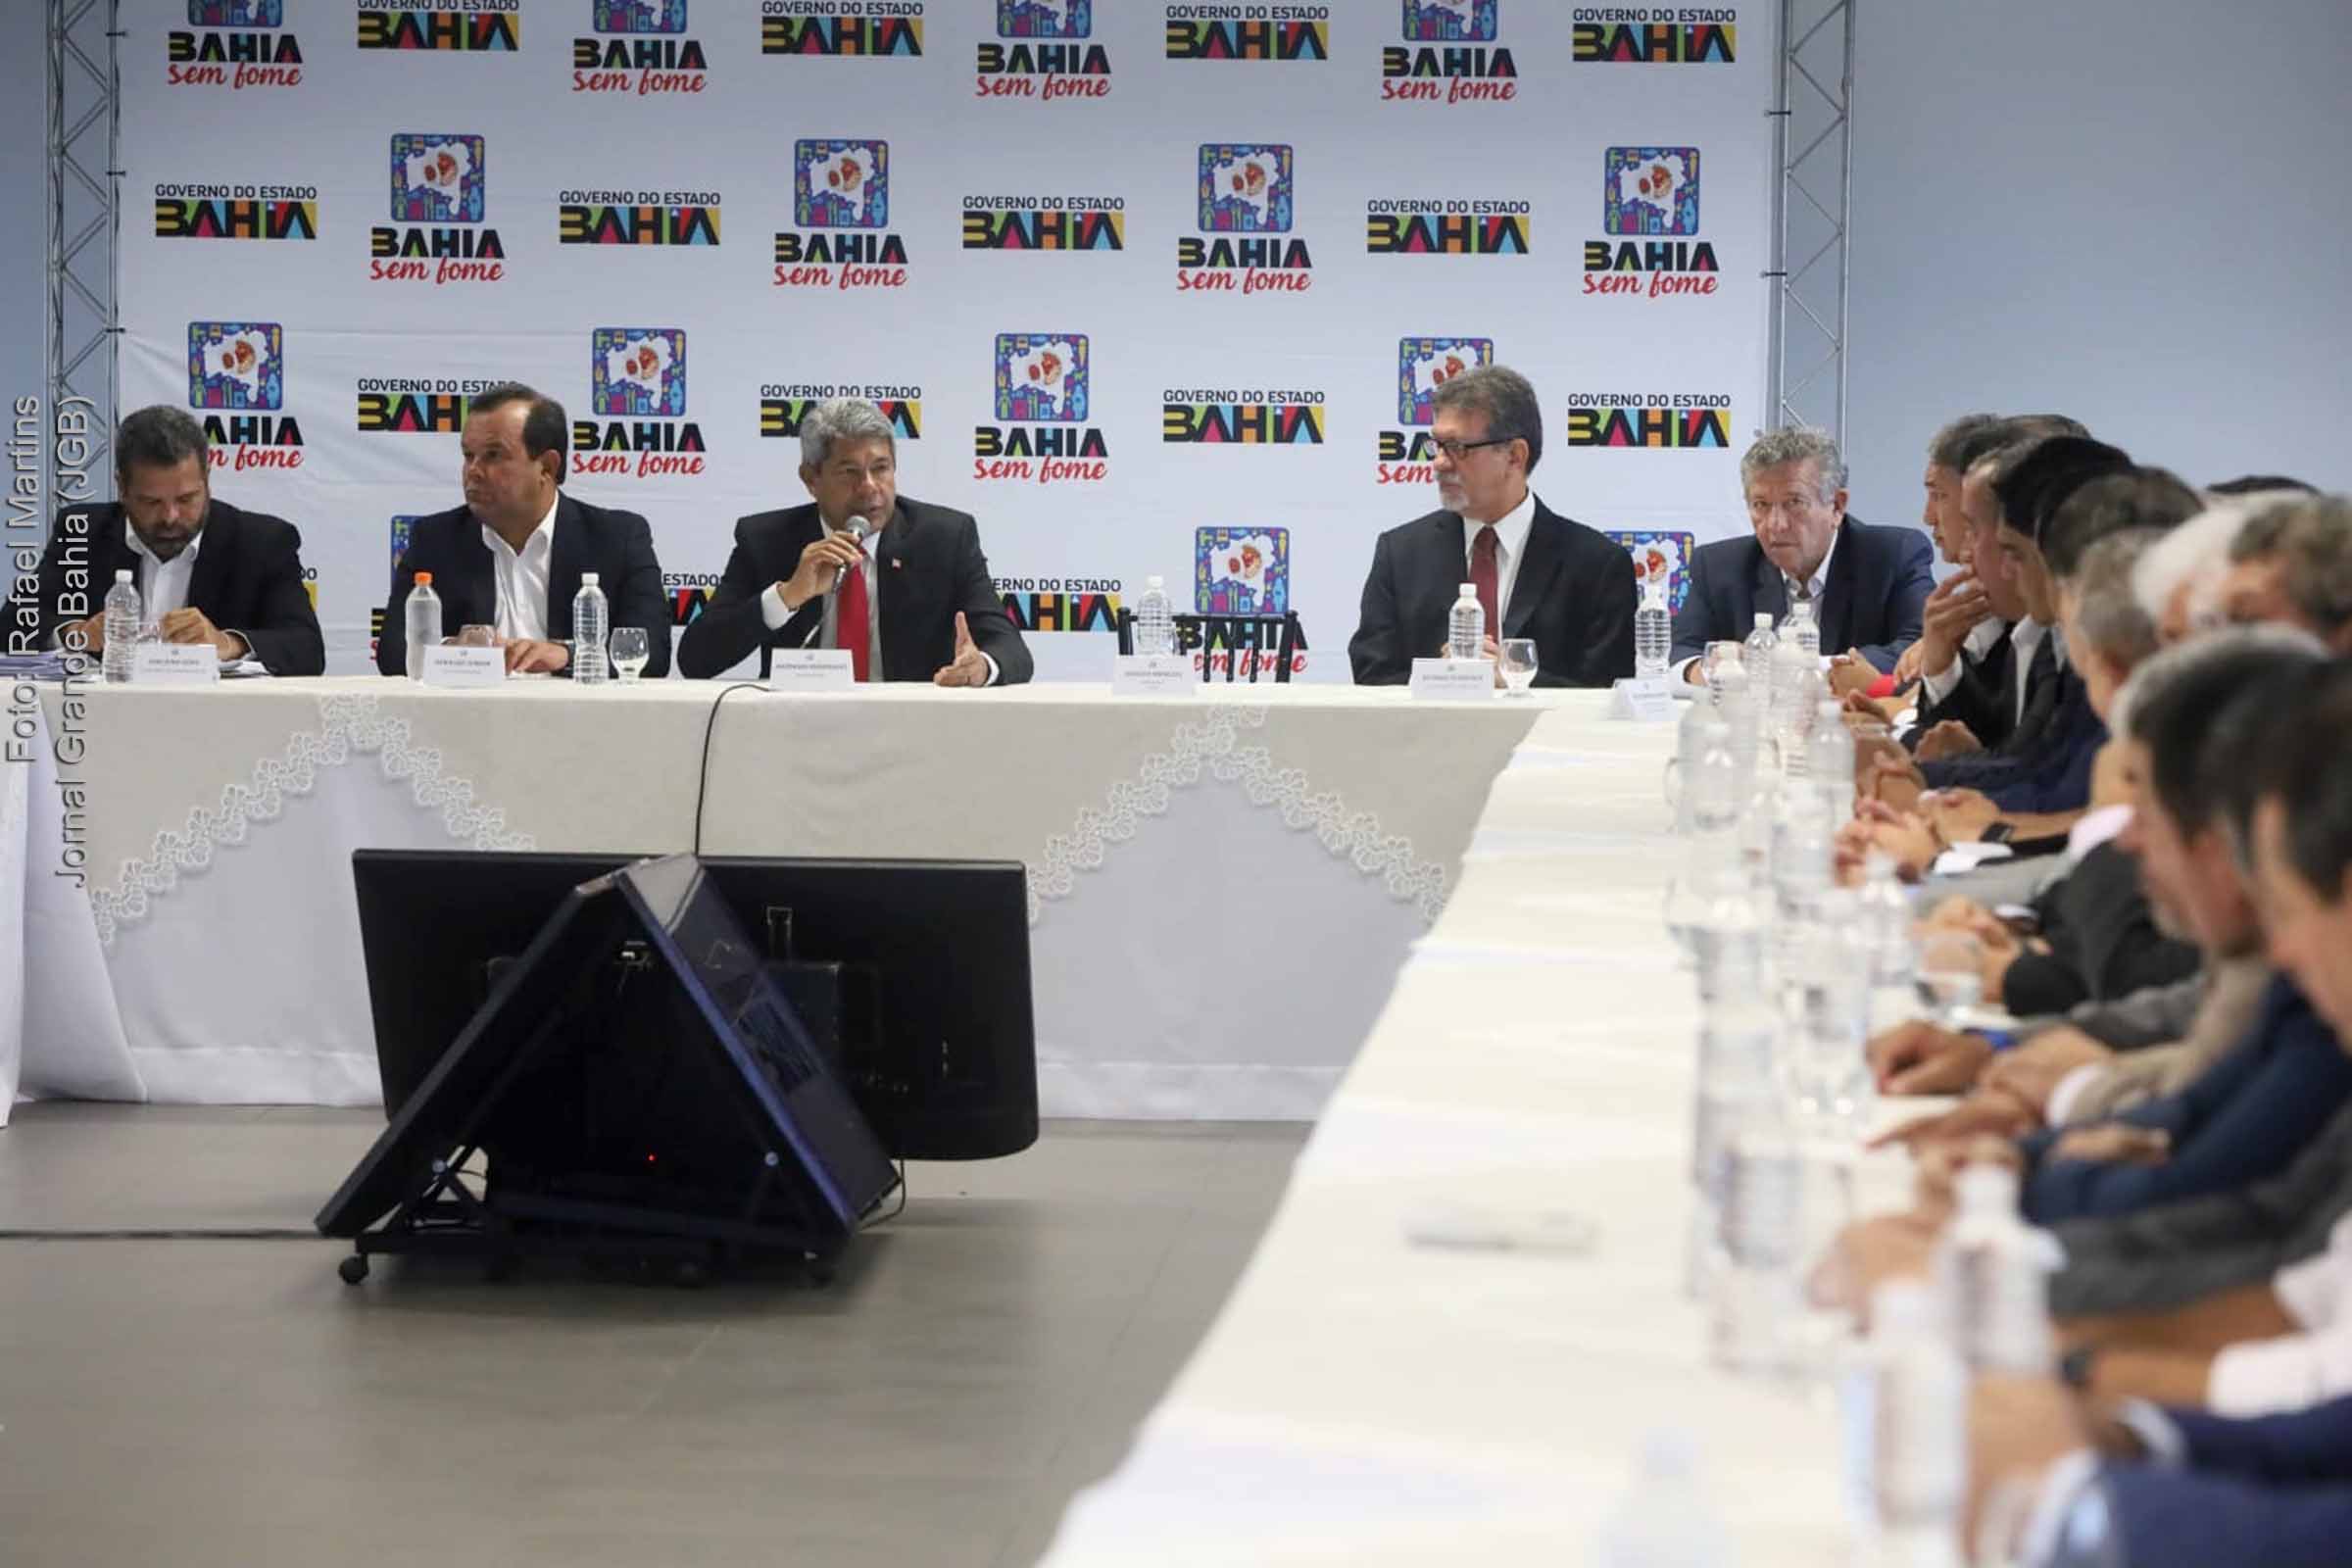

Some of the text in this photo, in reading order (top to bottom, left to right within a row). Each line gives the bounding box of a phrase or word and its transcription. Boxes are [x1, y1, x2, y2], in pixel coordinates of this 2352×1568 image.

[358, 0, 519, 11] GOVERNO DO ESTADO
[761, 2, 923, 17] GOVERNO DO ESTADO
[1166, 6, 1328, 21] GOVERNO DO ESTADO
[1573, 9, 1735, 24] GOVERNO DO ESTADO
[358, 11, 519, 49] BAHIA
[761, 17, 923, 55] BAHIA
[1166, 21, 1328, 59] BAHIA
[1573, 24, 1735, 62] BAHIA
[170, 32, 303, 63] BAHIA
[574, 39, 708, 70] BAHIA
[978, 44, 1111, 74] BAHIA
[1384, 47, 1517, 77] BAHIA
[168, 60, 302, 89] sem fome
[572, 67, 707, 96] sem fome
[976, 72, 1110, 101] sem fome
[1382, 74, 1516, 104] sem fome
[155, 184, 317, 199] GOVERNO DO ESTADO
[559, 191, 720, 206] GOVERNO DO ESTADO
[962, 196, 1124, 211] GOVERNO DO ESTADO
[155, 199, 317, 237] BAHIA
[1367, 200, 1529, 215] GOVERNO DO ESTADO
[559, 206, 720, 244] BAHIA
[962, 211, 1124, 249] BAHIA
[1367, 215, 1529, 253] BAHIA
[372, 227, 506, 258] BAHIA
[775, 233, 908, 264] BAHIA
[1179, 238, 1312, 269] BAHIA
[1586, 241, 1719, 271] BAHIA
[370, 255, 505, 284] sem fome
[773, 261, 907, 290] sem fome
[1177, 266, 1311, 295] sem fome
[1584, 269, 1718, 298] sem fome
[358, 378, 432, 391] GOVERNO
[437, 379, 459, 392] DO
[760, 385, 921, 400] GOVERNO DO ESTADO
[1162, 390, 1324, 405] GOVERNO DO ESTADO
[358, 393, 471, 432] BAH
[1568, 394, 1730, 409] GOVERNO DO ESTADO
[204, 415, 304, 446] AHIA
[573, 421, 707, 452] BAHIA
[1162, 405, 1324, 443] BAHIA
[1568, 409, 1730, 447] BAHIA
[235, 442, 305, 471] fome
[975, 427, 1108, 458] BAHIA
[571, 449, 706, 478] sem fome
[973, 455, 1107, 484] sem fome
[1377, 463, 1434, 484] sem
[662, 573, 719, 587] ESTADO
[1039, 579, 1060, 592] DO
[1064, 580, 1121, 593] ESTADO
[1000, 593, 1121, 632] AHIA
